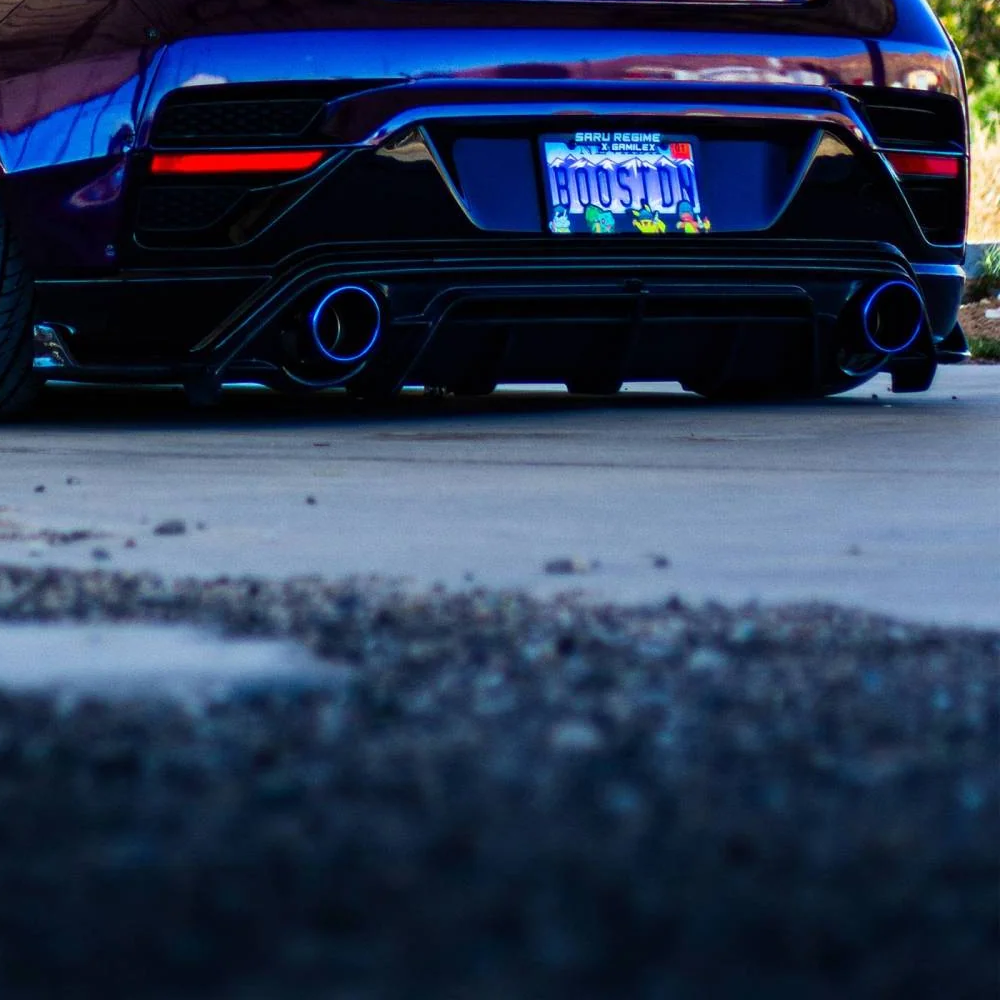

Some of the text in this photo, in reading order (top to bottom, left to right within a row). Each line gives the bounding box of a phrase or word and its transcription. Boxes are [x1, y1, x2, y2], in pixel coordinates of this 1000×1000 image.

[575, 132, 661, 142] SARU REGIME
[601, 143, 656, 151] X GAMILEX
